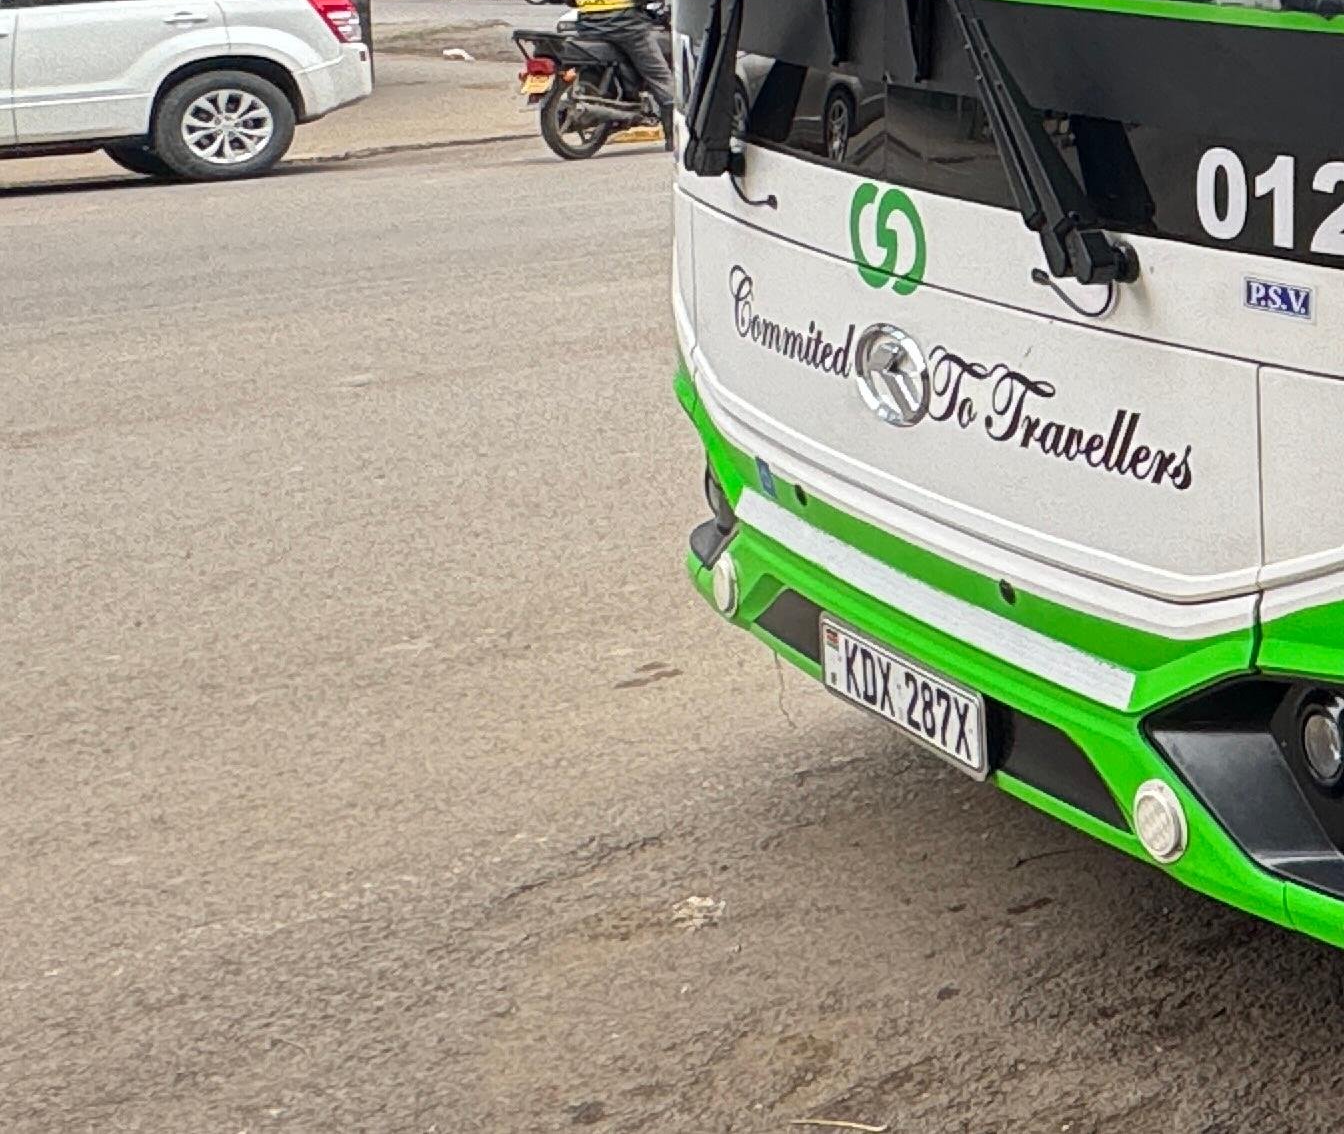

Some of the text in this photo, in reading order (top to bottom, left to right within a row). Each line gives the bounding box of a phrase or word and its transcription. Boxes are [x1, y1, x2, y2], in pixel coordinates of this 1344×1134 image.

[1250, 281, 1307, 314] P.S.V.
[730, 265, 1194, 491] Commited To Travellers
[842, 639, 973, 761] KDX 287X
